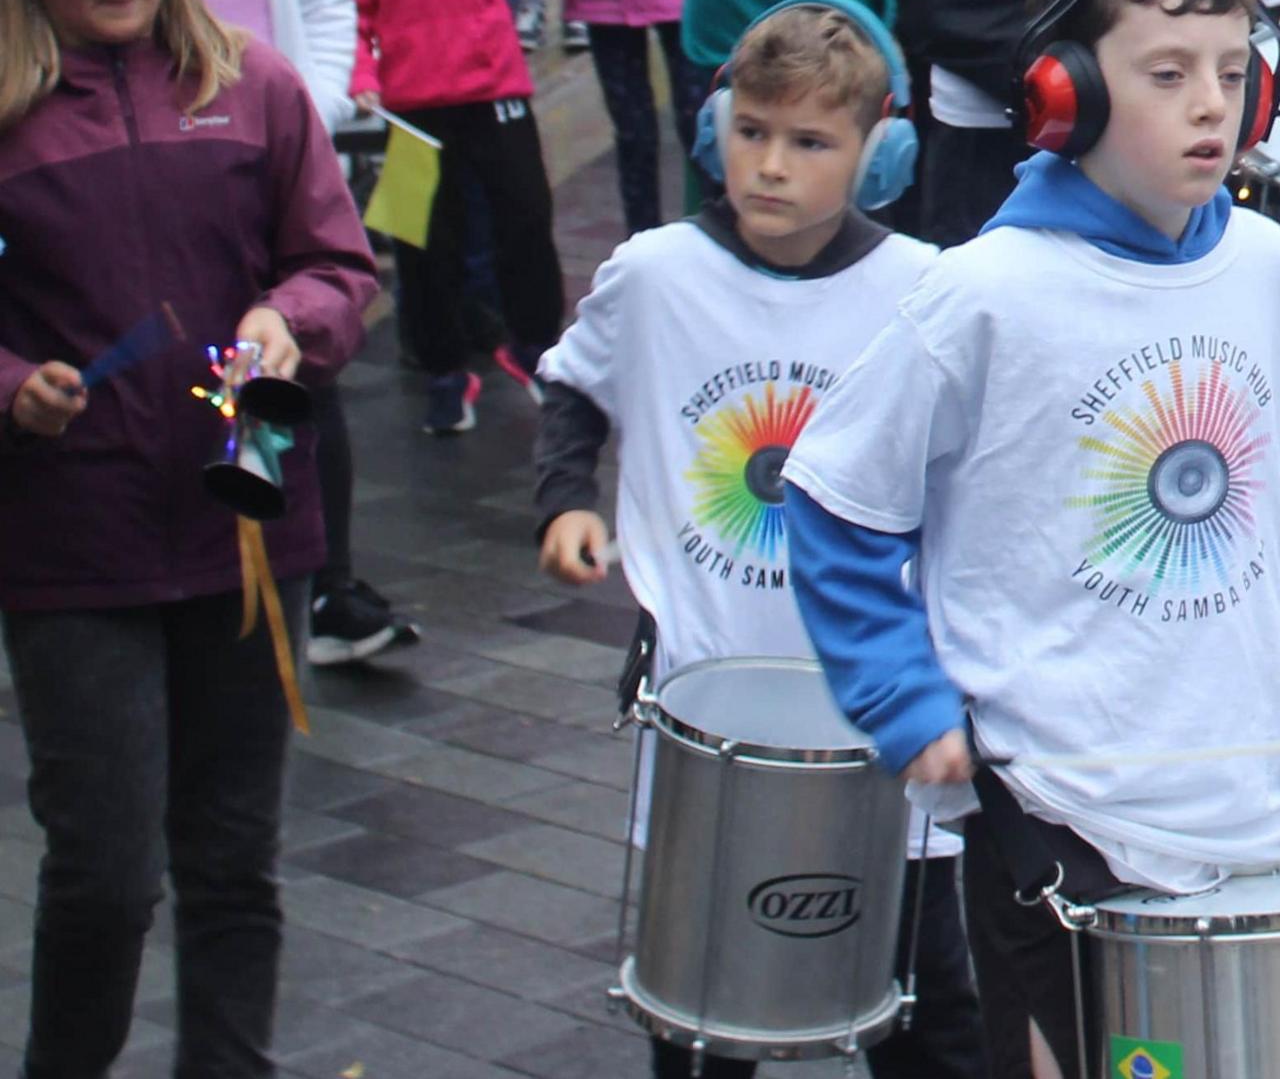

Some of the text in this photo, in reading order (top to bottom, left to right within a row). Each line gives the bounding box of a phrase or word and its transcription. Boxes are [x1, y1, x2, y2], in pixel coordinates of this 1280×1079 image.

[680, 360, 781, 424] SHEFFIELD
[1071, 334, 1273, 426] SHEFFIELD MUSIC HUB
[677, 521, 784, 590] YOUTH SAM
[1071, 558, 1149, 617] YOUTH
[1161, 585, 1241, 622] SAMBA
[761, 886, 857, 920] OZZI
